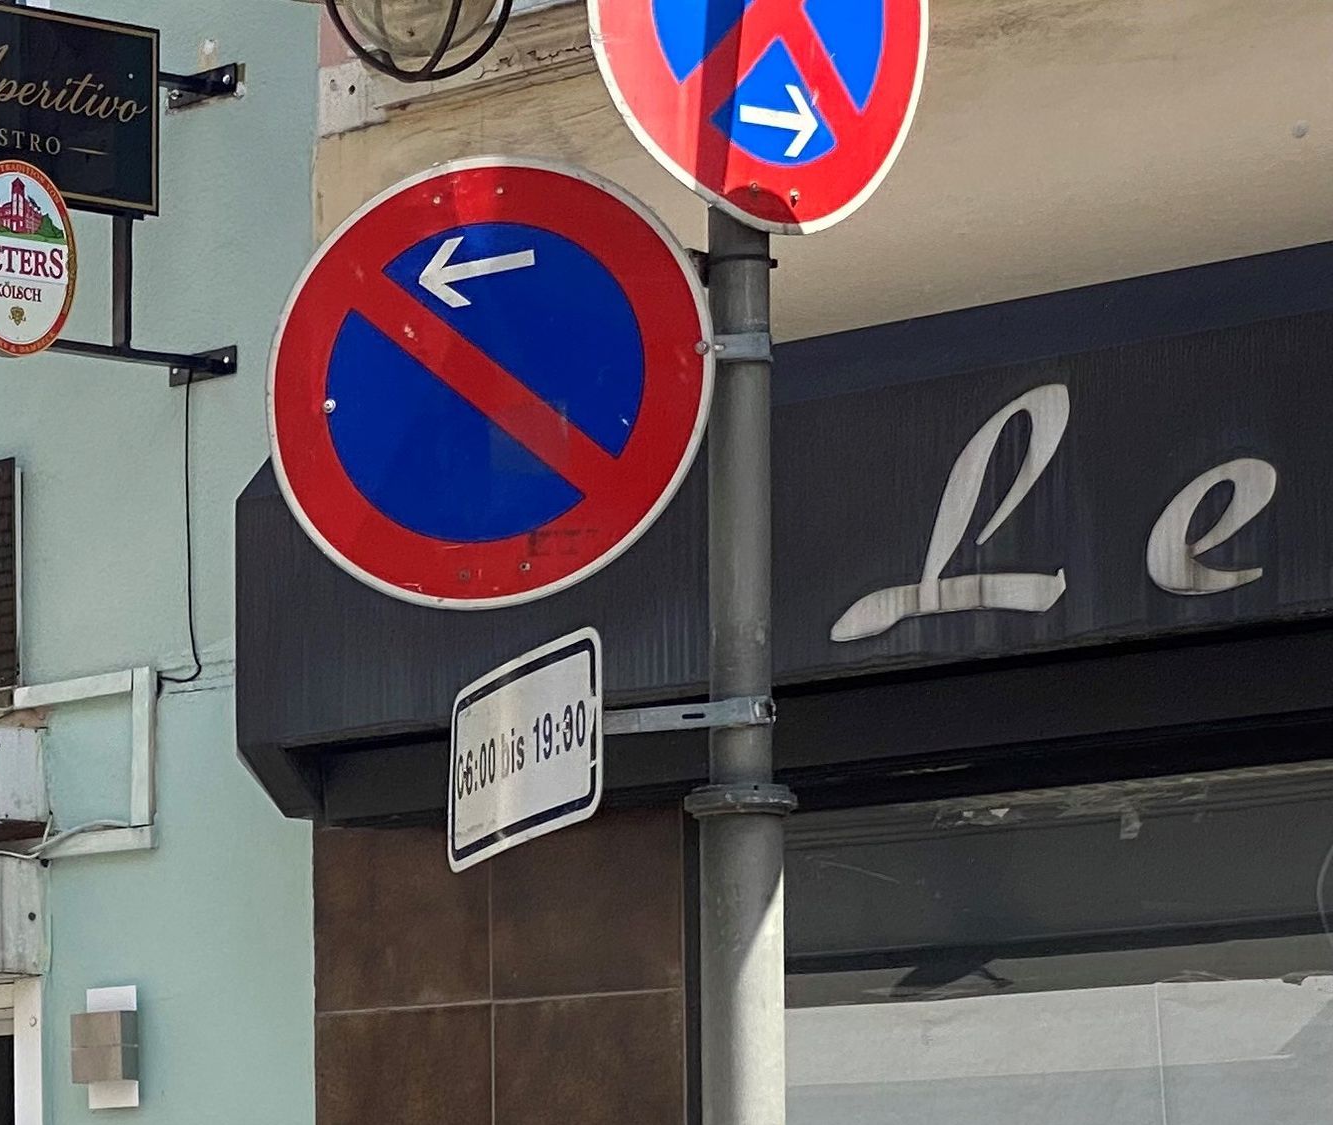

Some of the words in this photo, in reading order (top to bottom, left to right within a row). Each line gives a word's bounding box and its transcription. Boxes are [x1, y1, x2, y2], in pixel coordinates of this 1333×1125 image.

[0, 163, 47, 184] TRADITION
[501, 728, 525, 779] bis
[533, 700, 586, 764] 19:30
